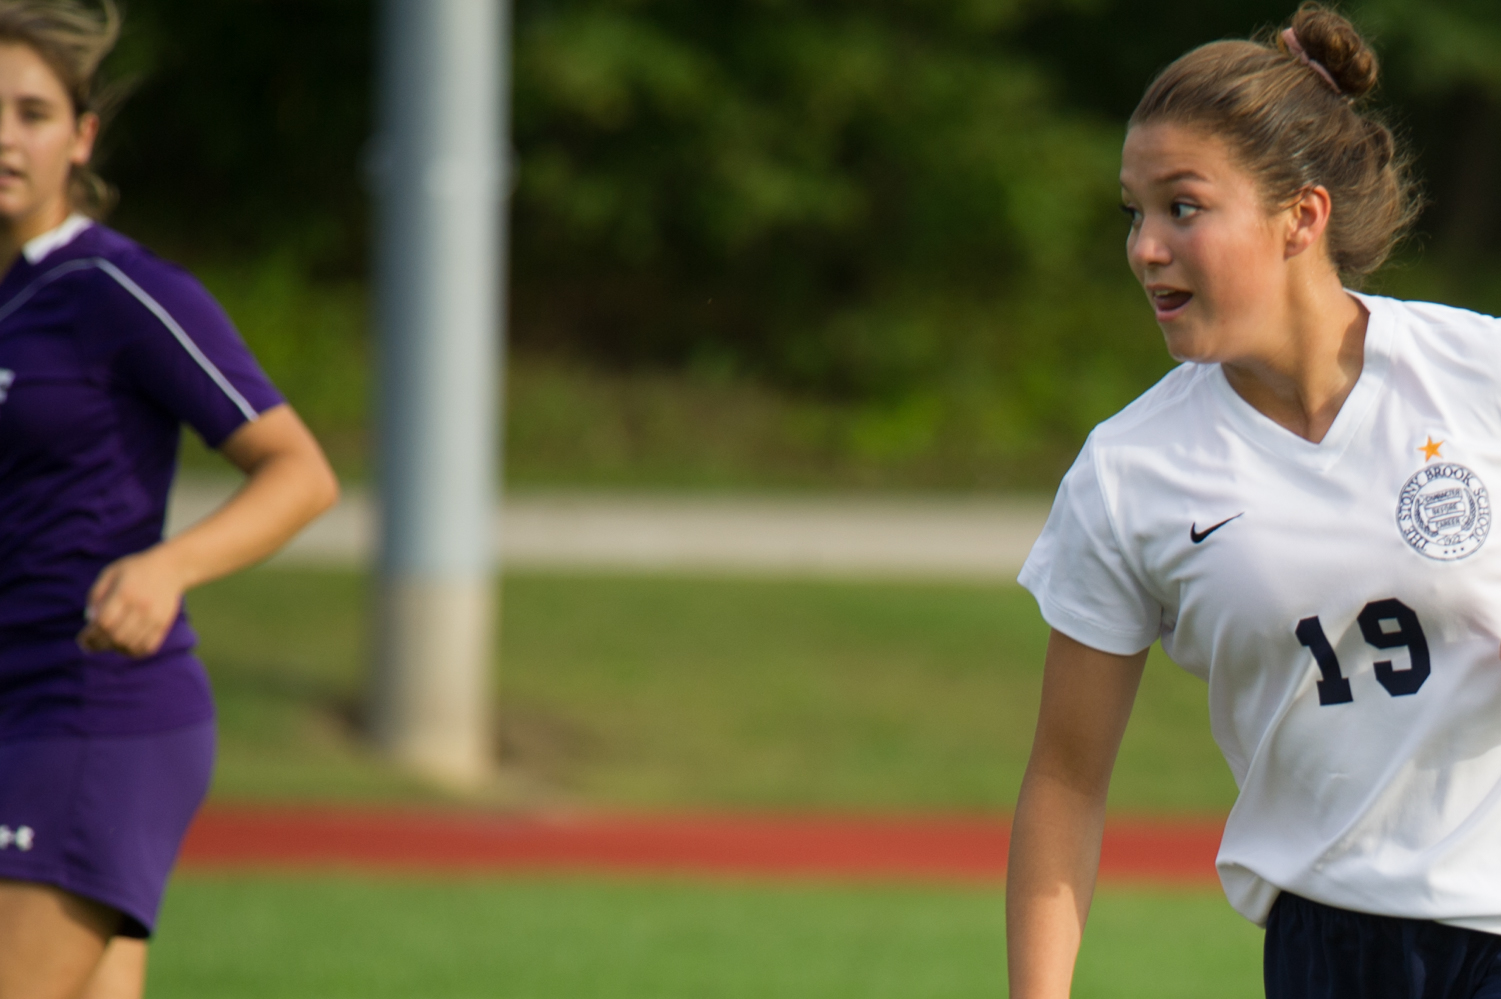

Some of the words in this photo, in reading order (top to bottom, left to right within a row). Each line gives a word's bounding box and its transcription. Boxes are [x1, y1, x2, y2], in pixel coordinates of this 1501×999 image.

[1399, 475, 1421, 521] STONY
[1425, 465, 1472, 487] BROOK
[1403, 525, 1430, 551] THE
[1468, 488, 1490, 543] SCHOOL
[1295, 597, 1431, 706] 19
